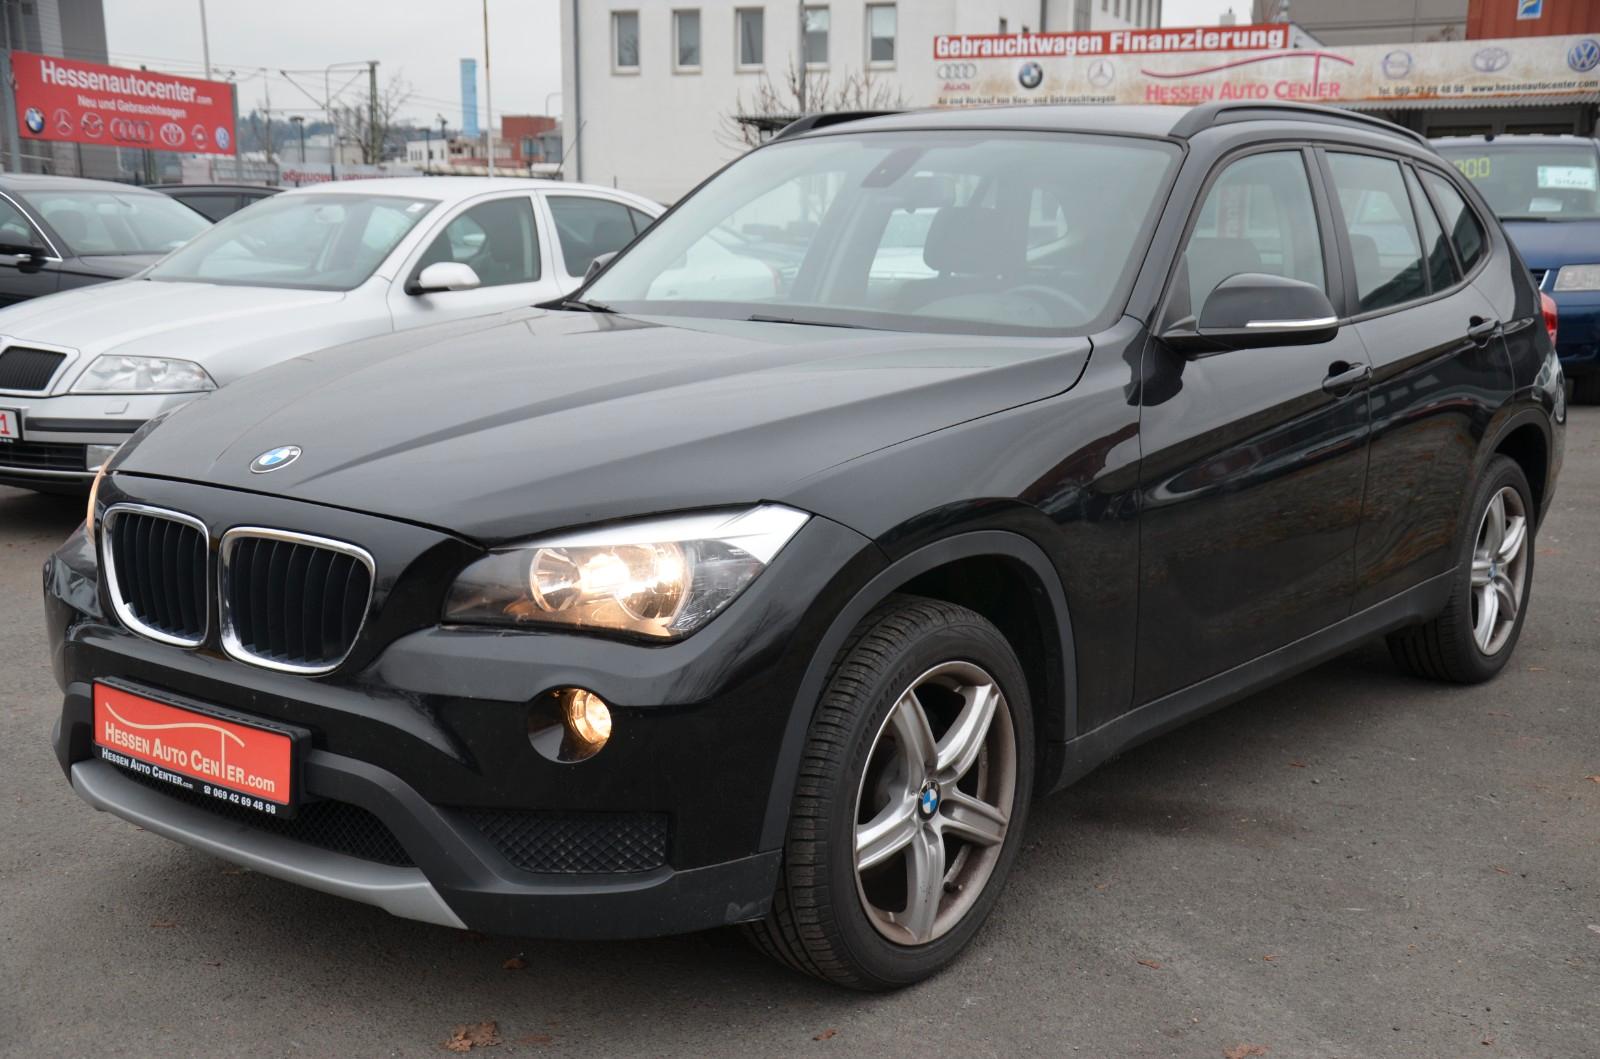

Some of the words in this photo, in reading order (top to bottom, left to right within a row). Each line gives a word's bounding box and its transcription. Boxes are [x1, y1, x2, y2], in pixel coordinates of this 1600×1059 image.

[936, 34, 1103, 56] Gebrauchtwagen
[1110, 28, 1285, 53] Finanzierung
[1145, 84, 1214, 100] HESSEN
[1219, 81, 1269, 99] AUTO
[1471, 79, 1599, 93] www.hessenautocenter.com
[78, 95, 97, 108] Neu
[99, 98, 116, 111] und
[118, 101, 187, 120] Gebrauchtwagen
[105, 721, 150, 755] HESSEN
[152, 738, 188, 766] AUTO
[101, 748, 129, 767] HESSEN
[130, 759, 151, 775] AUTO
[213, 788, 228, 800] 069
[229, 793, 239, 804] 42
[241, 796, 251, 807] 69
[253, 799, 264, 811] 48
[265, 803, 276, 814] 98
